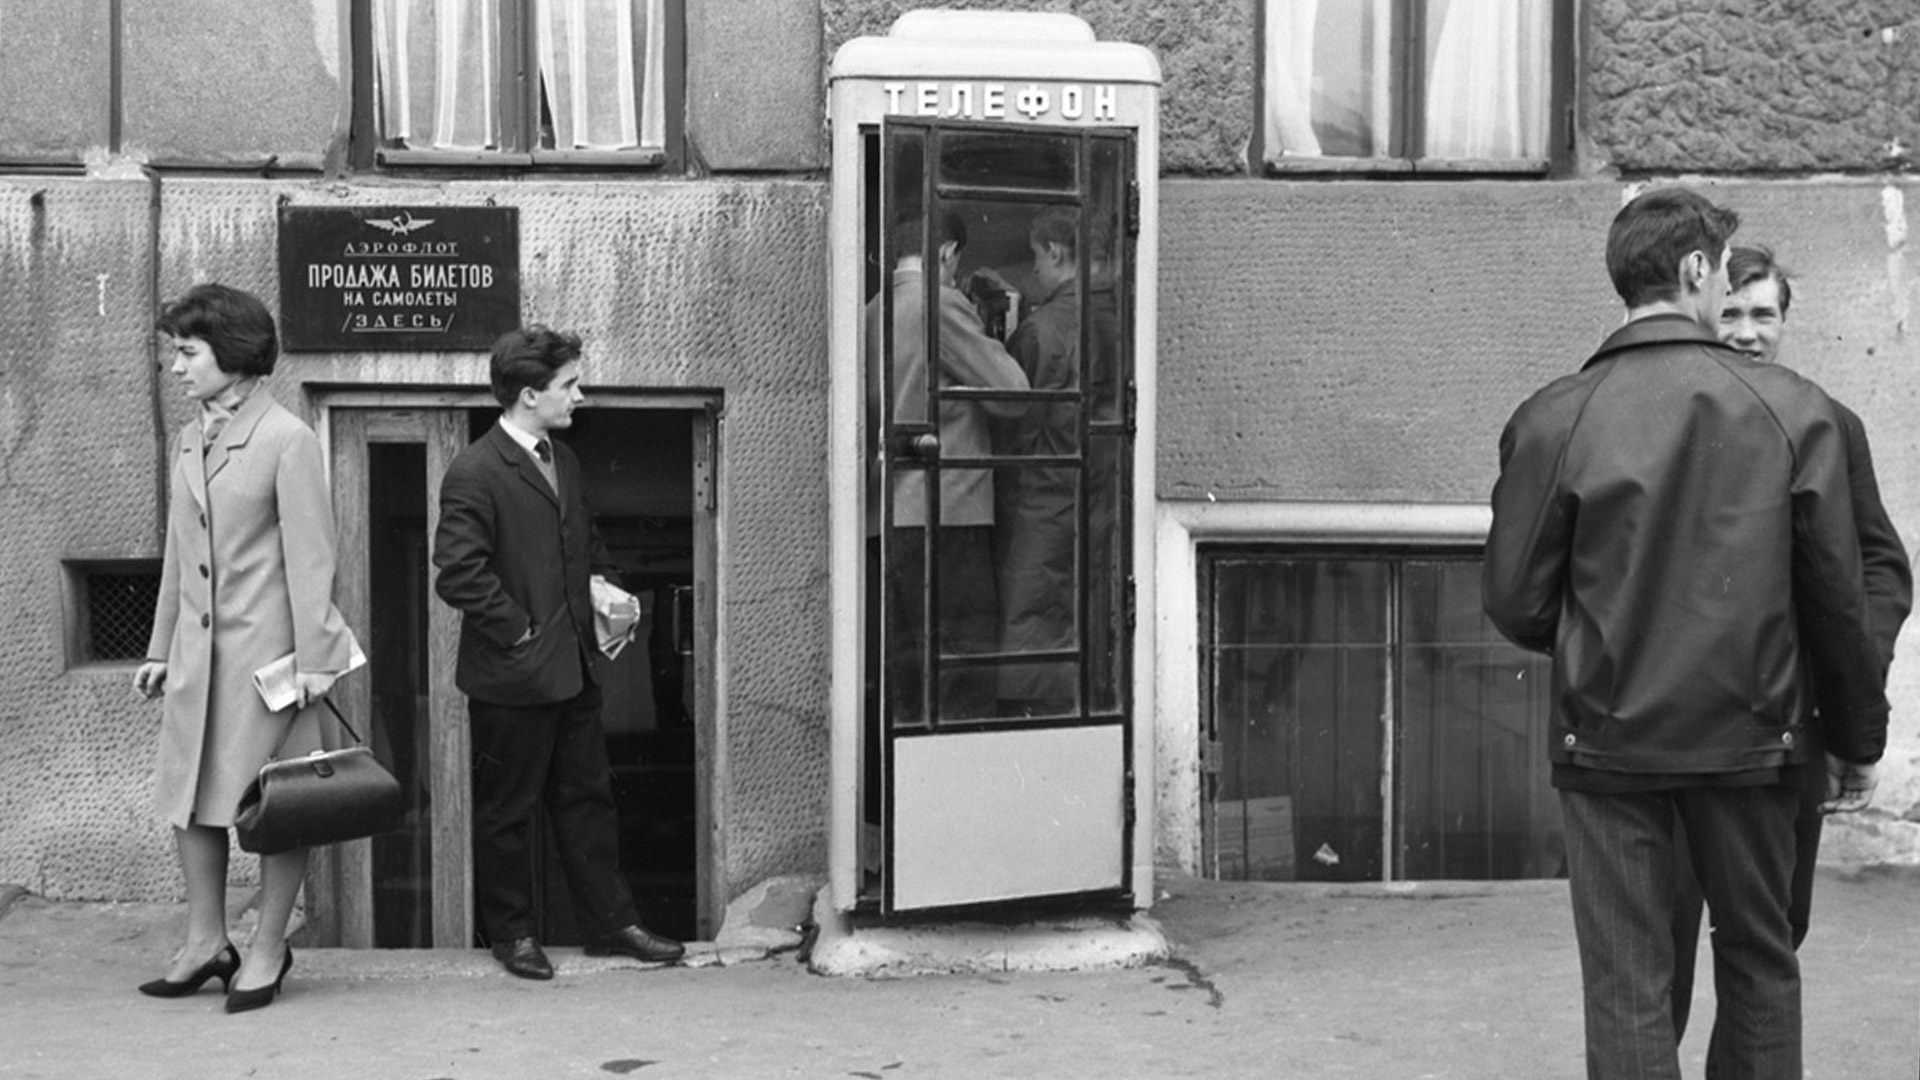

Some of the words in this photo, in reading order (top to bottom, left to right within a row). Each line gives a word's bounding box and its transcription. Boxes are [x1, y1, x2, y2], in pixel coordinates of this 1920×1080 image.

[884, 83, 1116, 120] ТЕЛЕФОН
[344, 242, 459, 254] АЭРОФЛОТ
[308, 264, 401, 288] ПРОДАЖА
[410, 264, 494, 288] БИЛЕТОВ
[343, 292, 364, 306] НА
[372, 292, 457, 306] САМОЛЕТЫ
